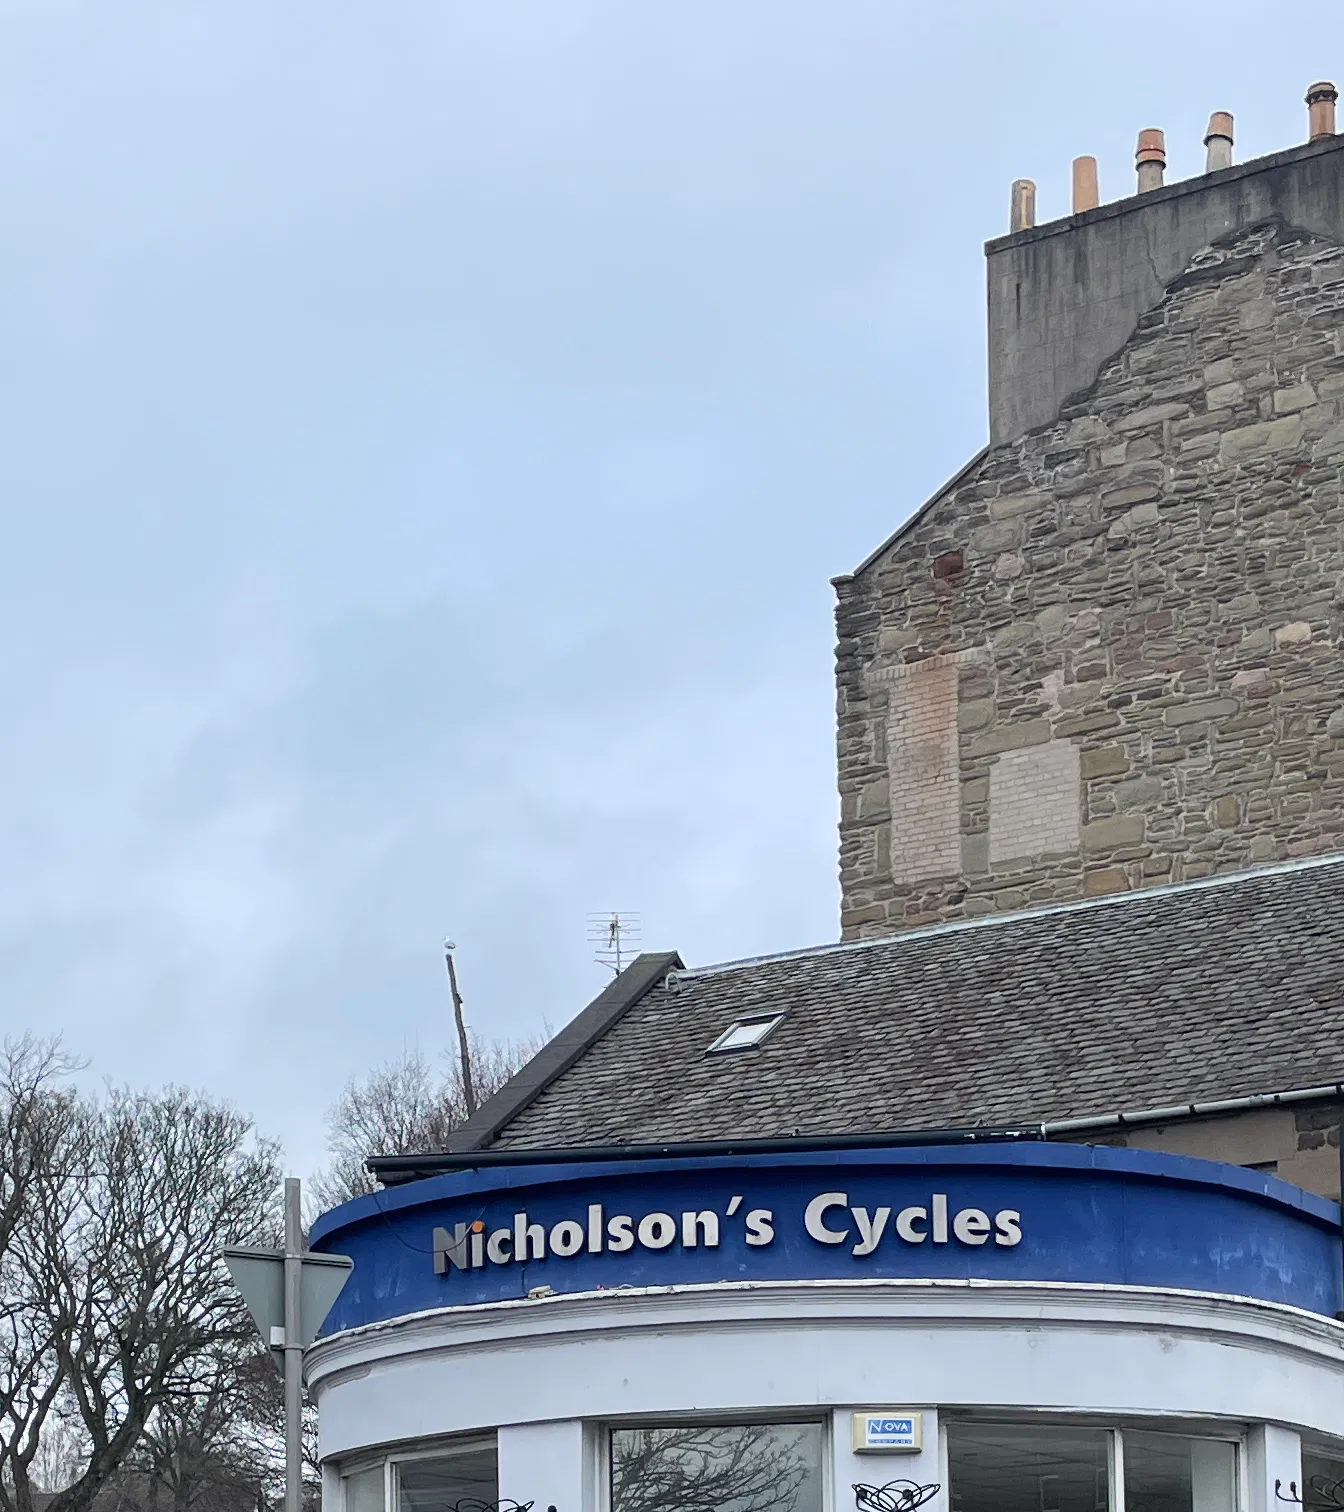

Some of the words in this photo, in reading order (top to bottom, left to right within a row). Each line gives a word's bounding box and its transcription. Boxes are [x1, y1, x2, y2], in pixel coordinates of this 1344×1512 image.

[433, 1195, 775, 1275] Nicholson's
[804, 1191, 1023, 1256] Cycles
[868, 1419, 909, 1435] NOVA
